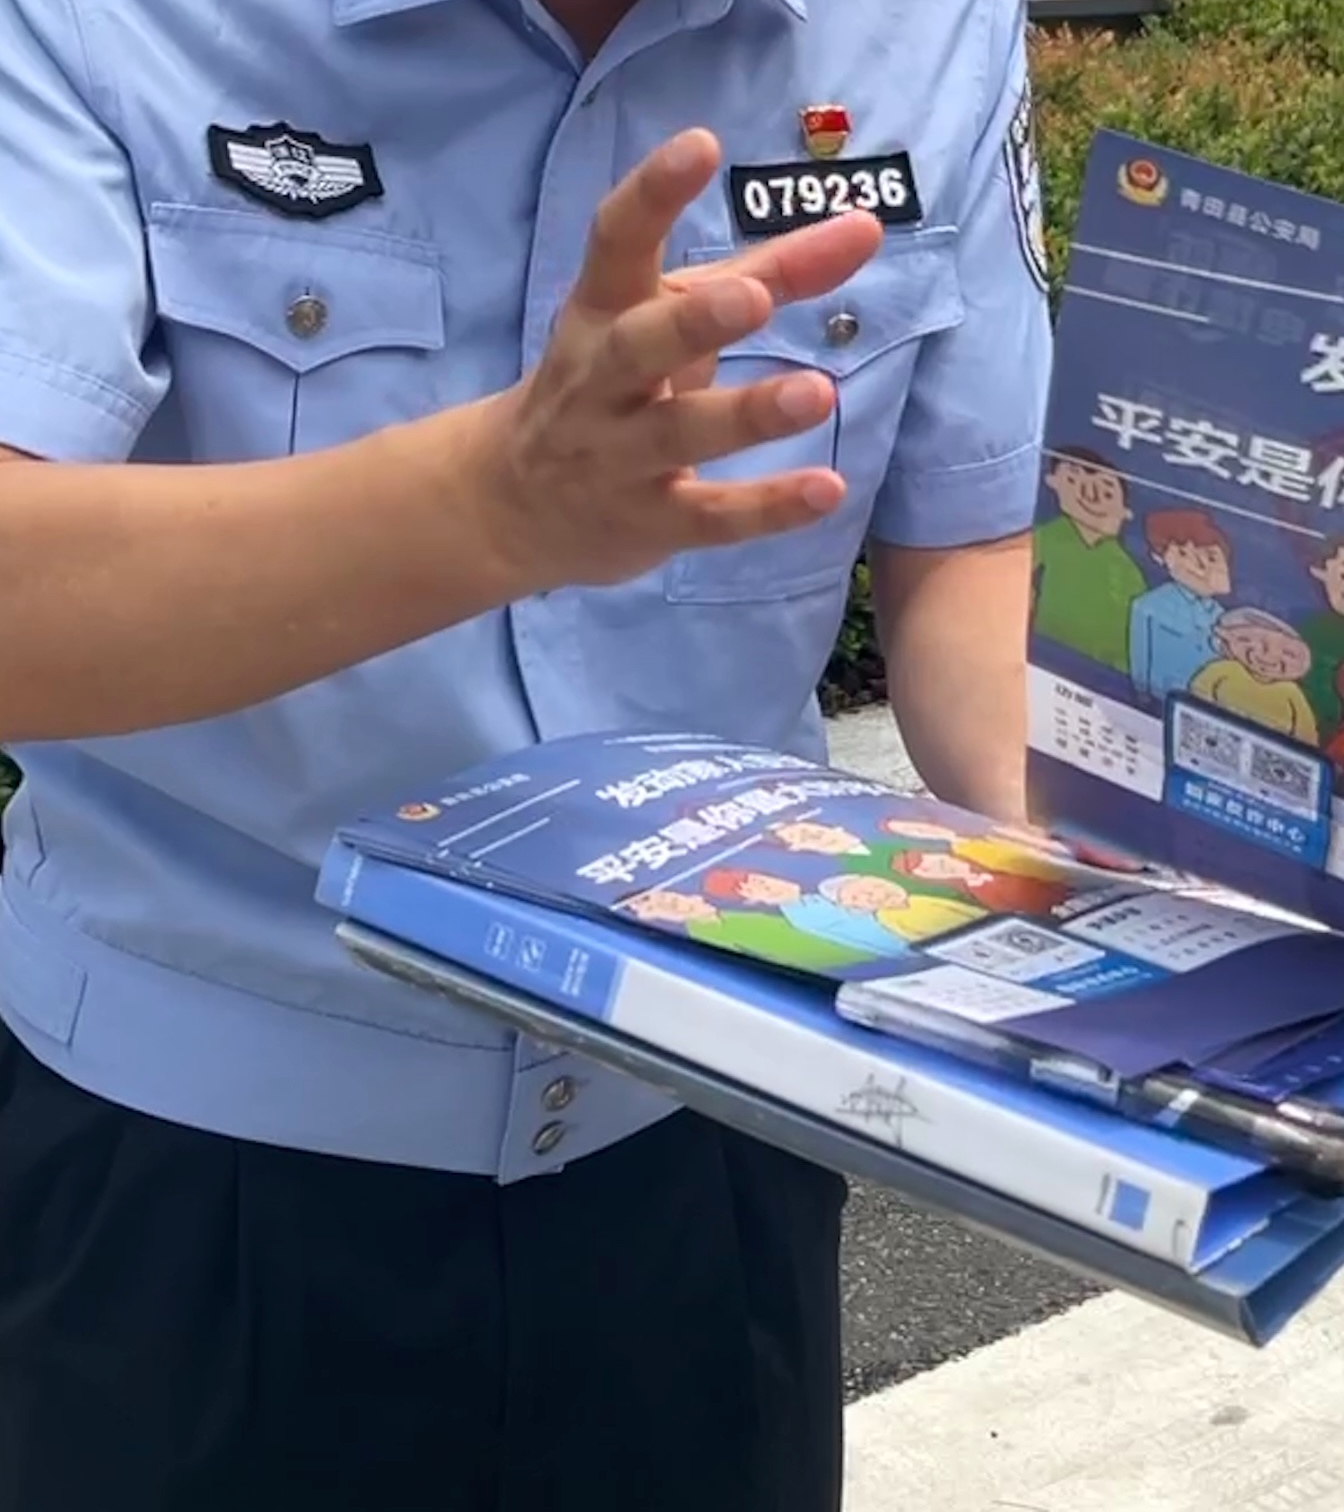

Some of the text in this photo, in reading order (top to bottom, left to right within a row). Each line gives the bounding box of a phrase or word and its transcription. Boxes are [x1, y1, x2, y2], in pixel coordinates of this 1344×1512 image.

[744, 168, 906, 219] 079236
[1180, 187, 1321, 251] 青田县公安局
